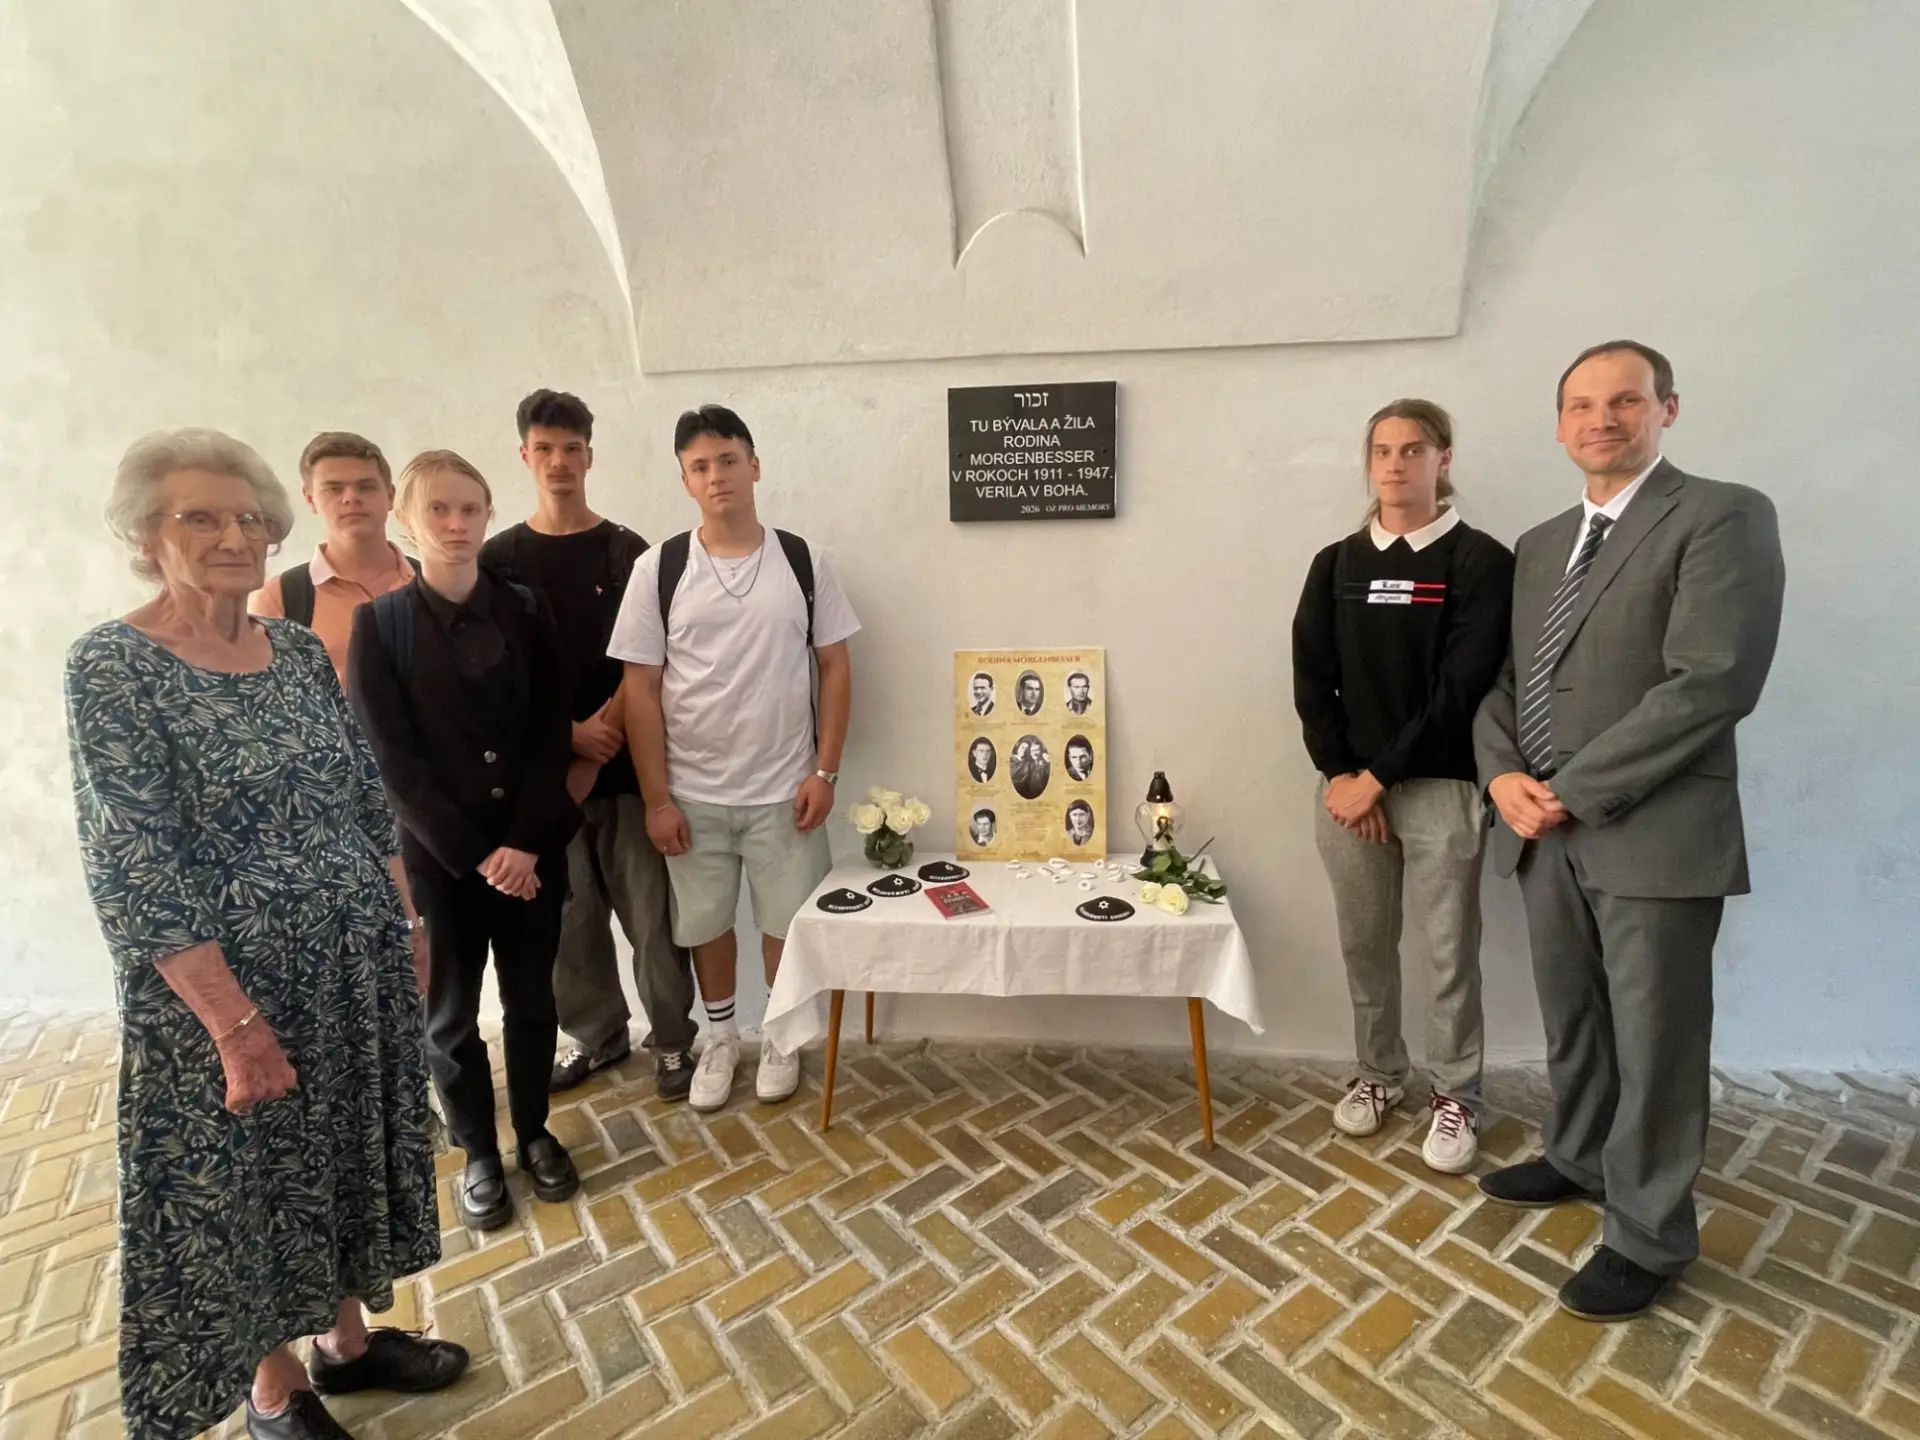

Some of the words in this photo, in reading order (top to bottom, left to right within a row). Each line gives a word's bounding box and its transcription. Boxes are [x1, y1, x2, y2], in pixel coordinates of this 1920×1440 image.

[1014, 392, 1049, 408] זכור
[970, 420, 989, 432] TU
[993, 417, 1049, 432] BÝVALA
[1050, 419, 1061, 430] A
[1064, 414, 1095, 429] ŽILA
[1004, 435, 1061, 448] RODINA
[970, 451, 1094, 465] MORGENBESSER
[952, 471, 961, 482] V
[965, 469, 1028, 482] ROKOCH
[1034, 468, 1062, 480] 1911
[1077, 467, 1113, 480] 1947.
[976, 486, 1026, 499] VERILA
[1030, 485, 1040, 497] V
[1044, 484, 1088, 497] BOHA.
[1058, 503, 1074, 512] PRO
